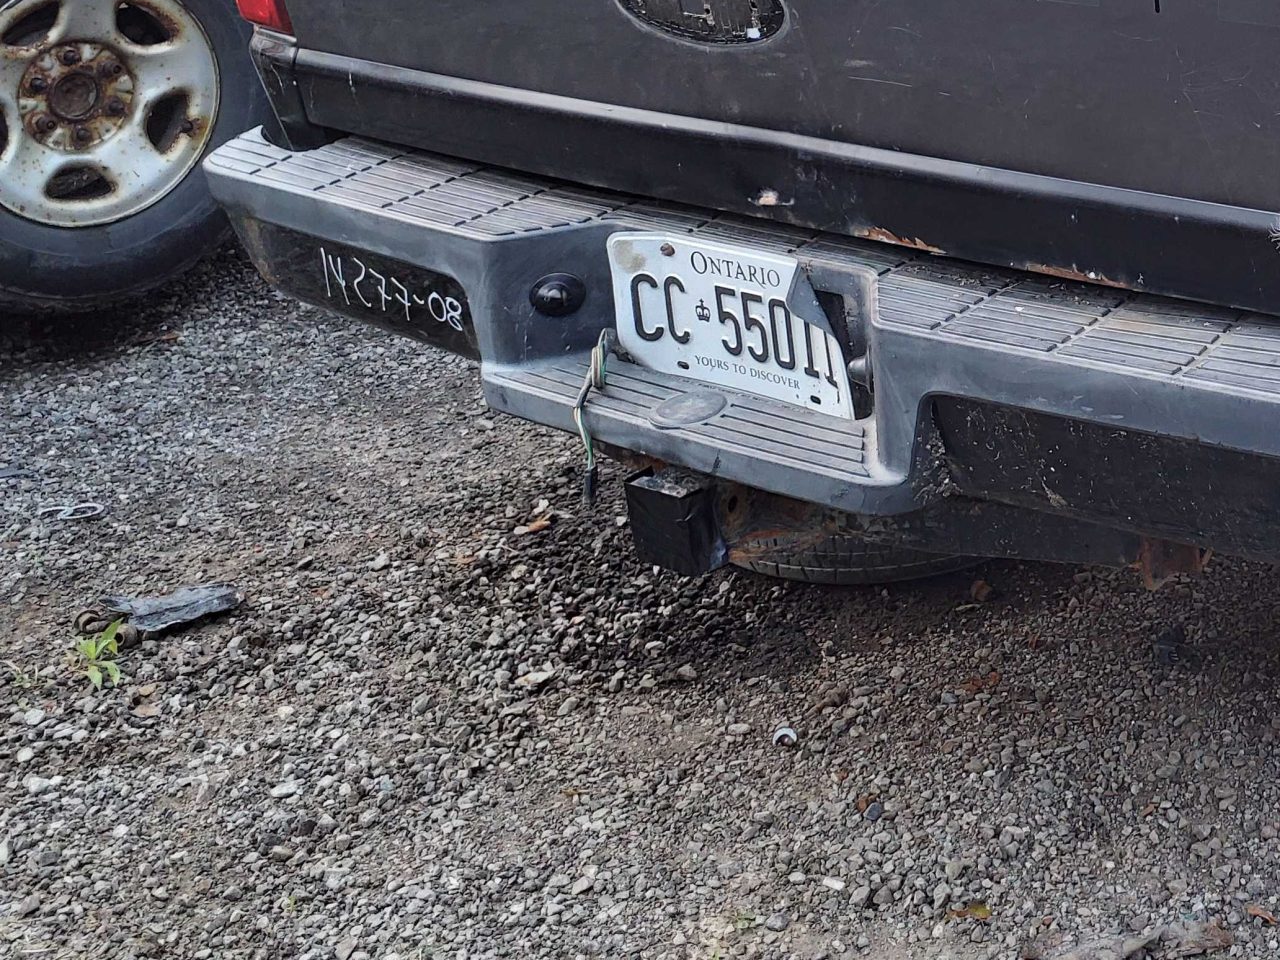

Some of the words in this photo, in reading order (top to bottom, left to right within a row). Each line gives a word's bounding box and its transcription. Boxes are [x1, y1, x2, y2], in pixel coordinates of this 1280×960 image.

[320, 246, 463, 332] 14277-08
[690, 250, 781, 289] ONTARIO
[630, 273, 691, 345] CC
[694, 354, 730, 372] YOURS
[732, 362, 747, 375] TO
[749, 367, 801, 390] DISCOVER
